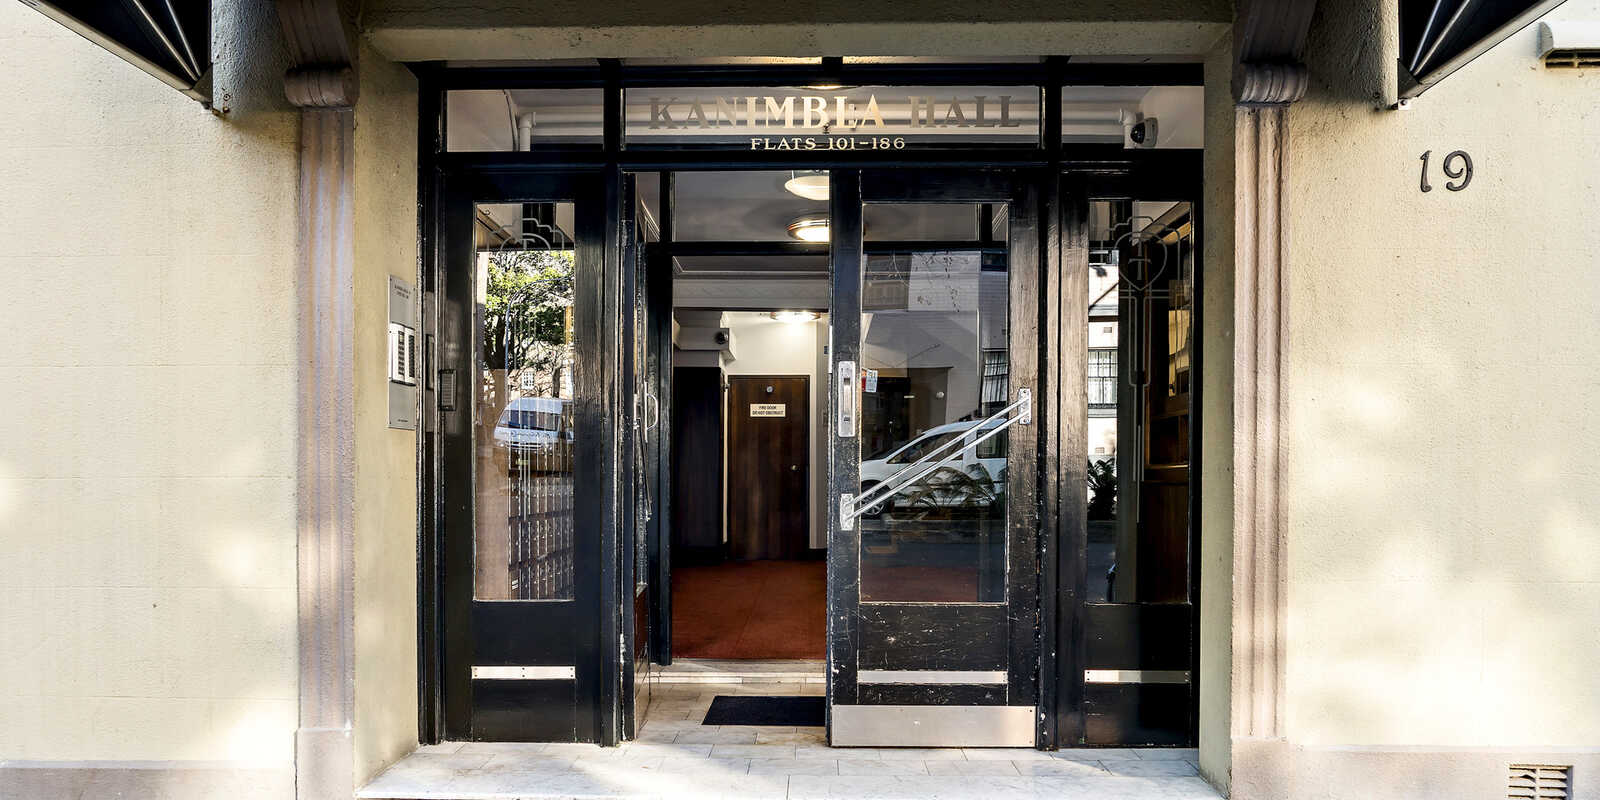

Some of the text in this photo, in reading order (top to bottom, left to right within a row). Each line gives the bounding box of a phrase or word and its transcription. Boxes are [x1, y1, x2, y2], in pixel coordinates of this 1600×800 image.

[649, 94, 1020, 130] KANIMBLA HALL
[750, 136, 906, 151] FLATS 101-186
[1420, 150, 1473, 193] 19
